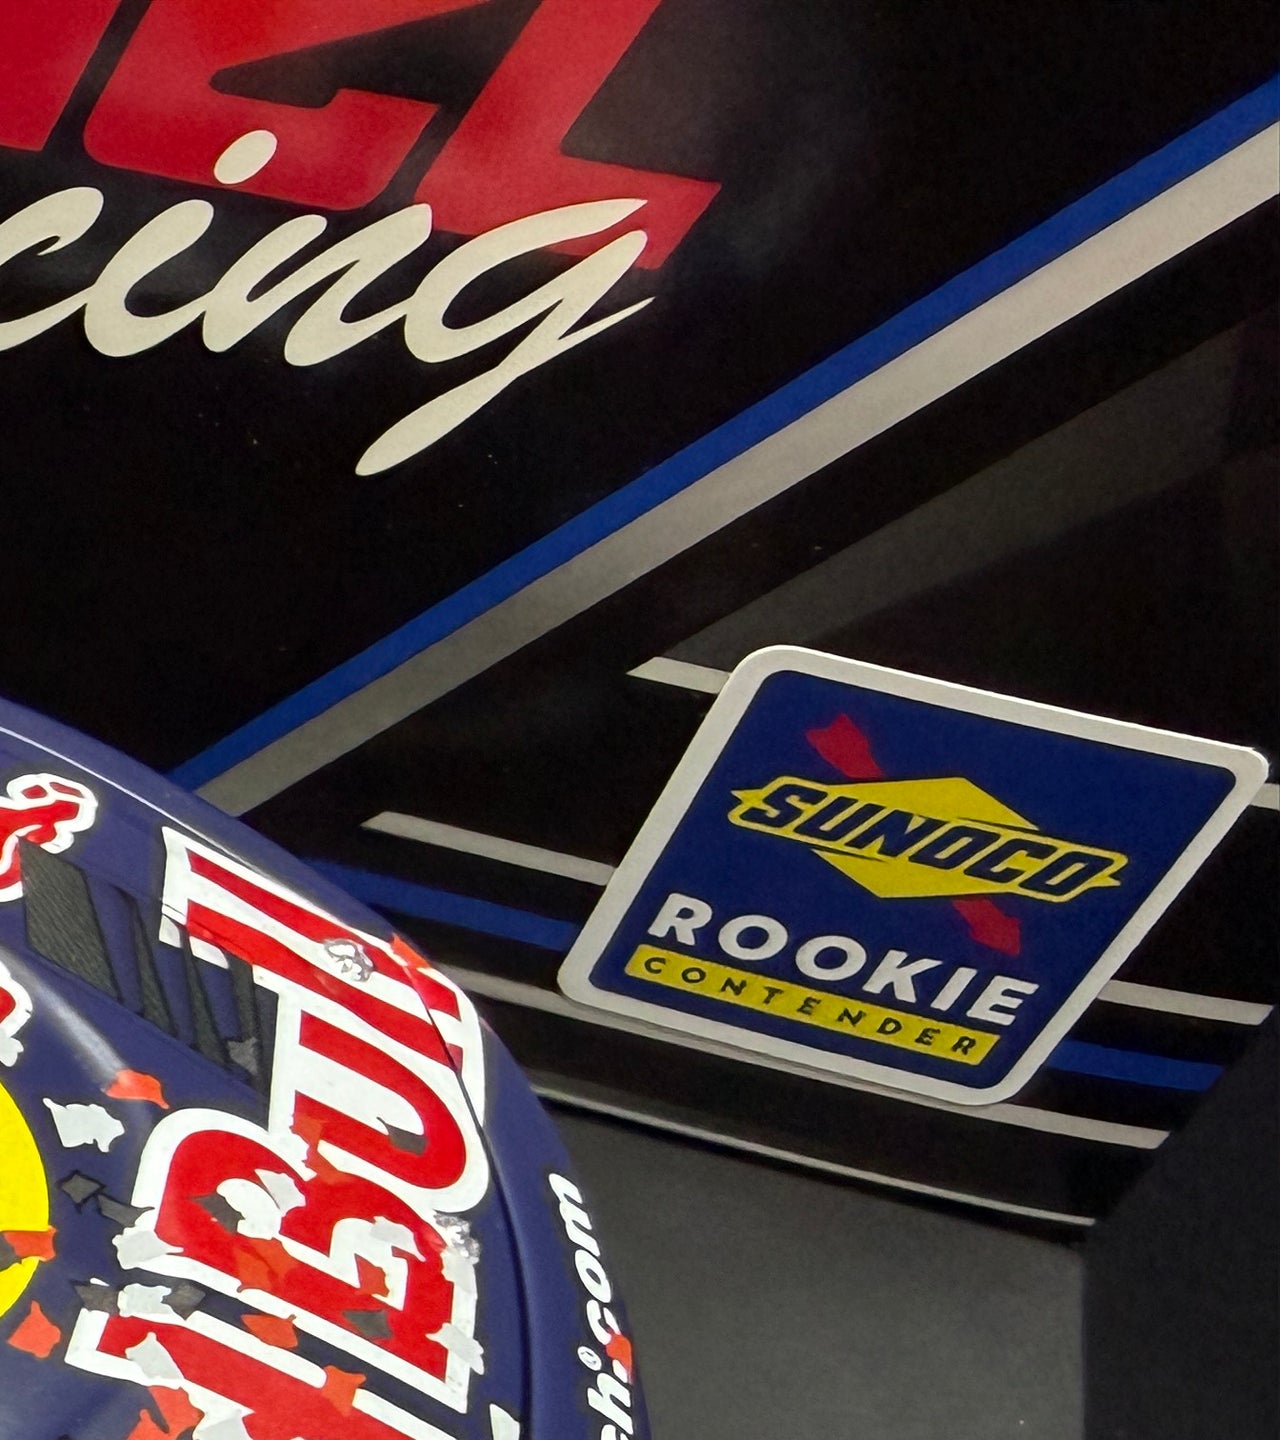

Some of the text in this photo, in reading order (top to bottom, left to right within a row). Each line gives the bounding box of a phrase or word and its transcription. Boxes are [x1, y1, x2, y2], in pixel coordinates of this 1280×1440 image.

[737, 782, 1113, 898] SUNOCO
[643, 955, 978, 1055] CONTENDER
[647, 893, 1039, 1028] ROOKIE
